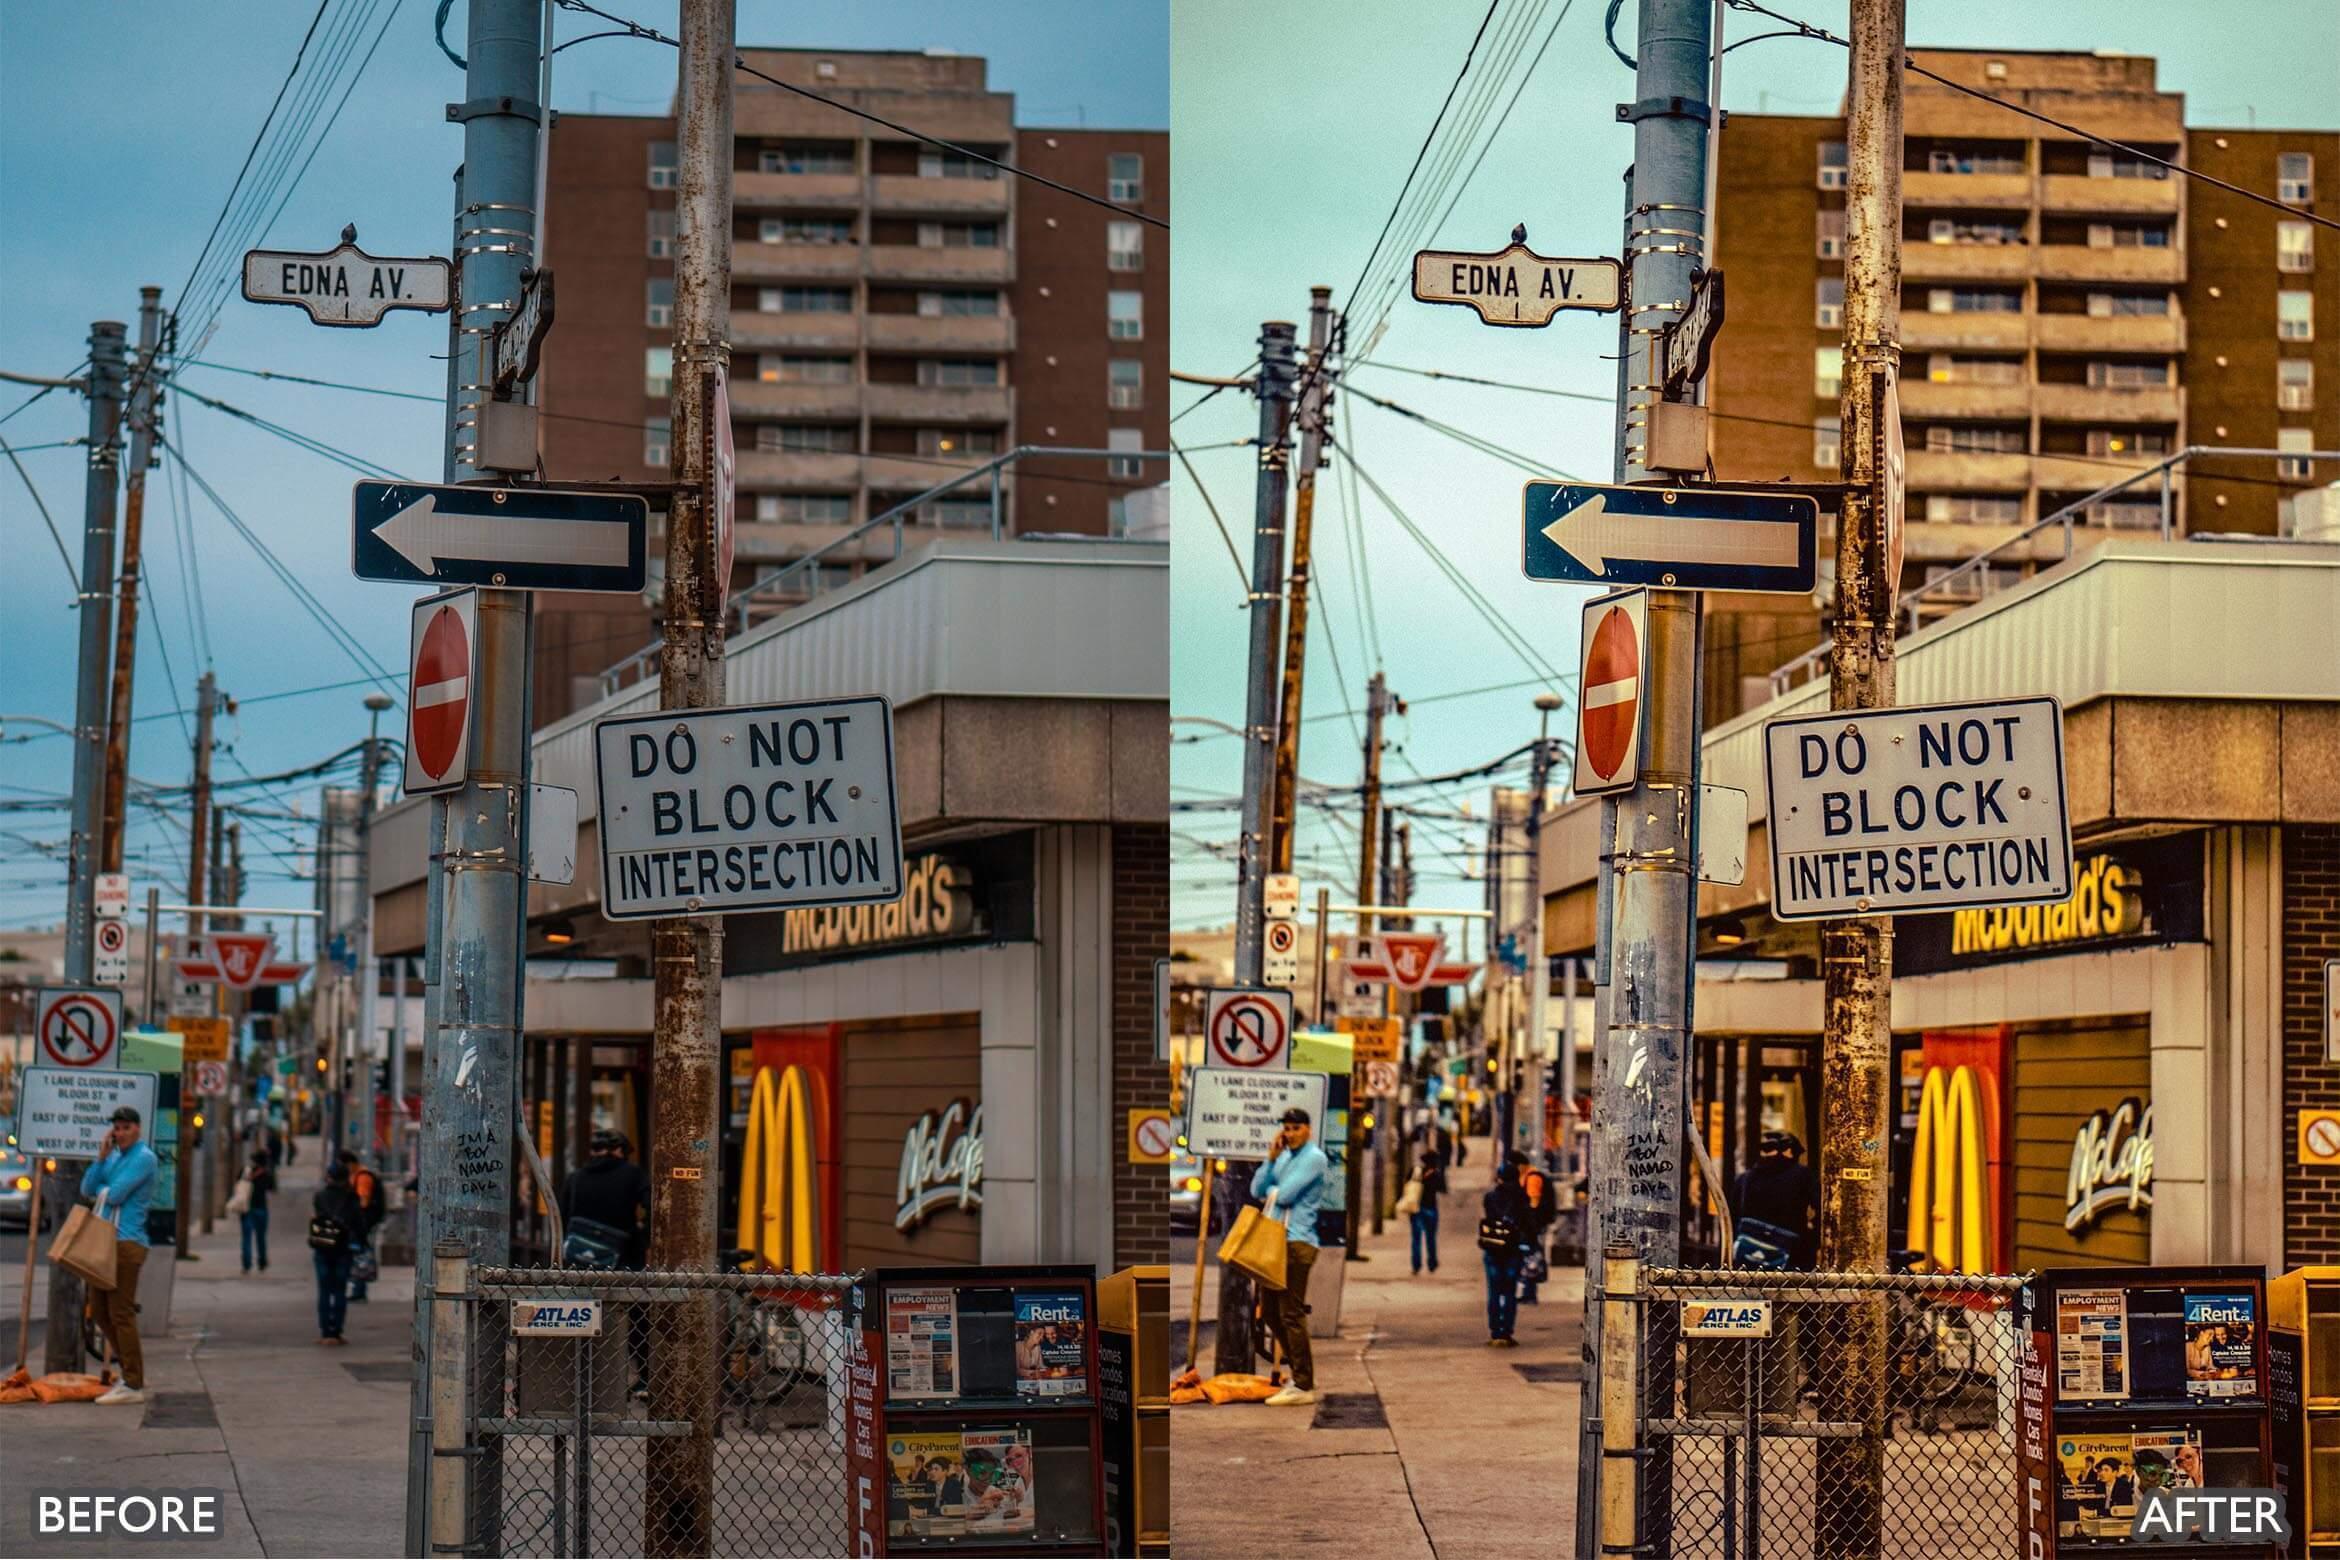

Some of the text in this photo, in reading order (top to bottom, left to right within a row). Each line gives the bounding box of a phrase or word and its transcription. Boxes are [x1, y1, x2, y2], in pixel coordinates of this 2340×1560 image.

[282, 263, 413, 299] EDNA AV.
[1452, 263, 1583, 299] EDNA AV.
[630, 716, 850, 778] DO NOT
[1800, 716, 2020, 778] DO NOT
[652, 778, 839, 836] BLOCK
[1822, 778, 2009, 836] BLOCK
[619, 836, 881, 900] INTERSECTION
[1789, 836, 2051, 900] INTERSECTION
[51, 1076, 75, 1086] LANE
[77, 1078, 119, 1088] CLOSURE
[122, 1080, 136, 1089] ON
[1221, 1076, 1245, 1086] LANE
[1247, 1078, 1289, 1088] CLOSURE
[1292, 1080, 1306, 1089] ON
[58, 1089, 90, 1099] BLOOR
[1228, 1089, 1260, 1099] BLOOR
[73, 1102, 101, 1112] FROM
[1243, 1102, 1271, 1112] FROM
[32, 1112, 55, 1122] EAST
[58, 1113, 69, 1123] OF
[1202, 1112, 1225, 1122] EAST
[1228, 1113, 1239, 1123] OF
[80, 1127, 92, 1137] TO
[1250, 1127, 1262, 1137] TO
[37, 1138, 62, 1148] WEST
[64, 1139, 76, 1149] OF
[1207, 1138, 1232, 1148] WEST
[1234, 1139, 1246, 1149] OF
[893, 1296, 950, 1304] EMPLOYMENT
[2063, 1297, 2120, 1305] EMPLOYMENT
[925, 1304, 950, 1312] NEWS
[2095, 1305, 2120, 1313] NEWS
[532, 1307, 592, 1322] ATLAS
[1702, 1308, 1762, 1323] ATLAS
[908, 1441, 960, 1453] CityParent
[2078, 1443, 2129, 1454] CityParent
